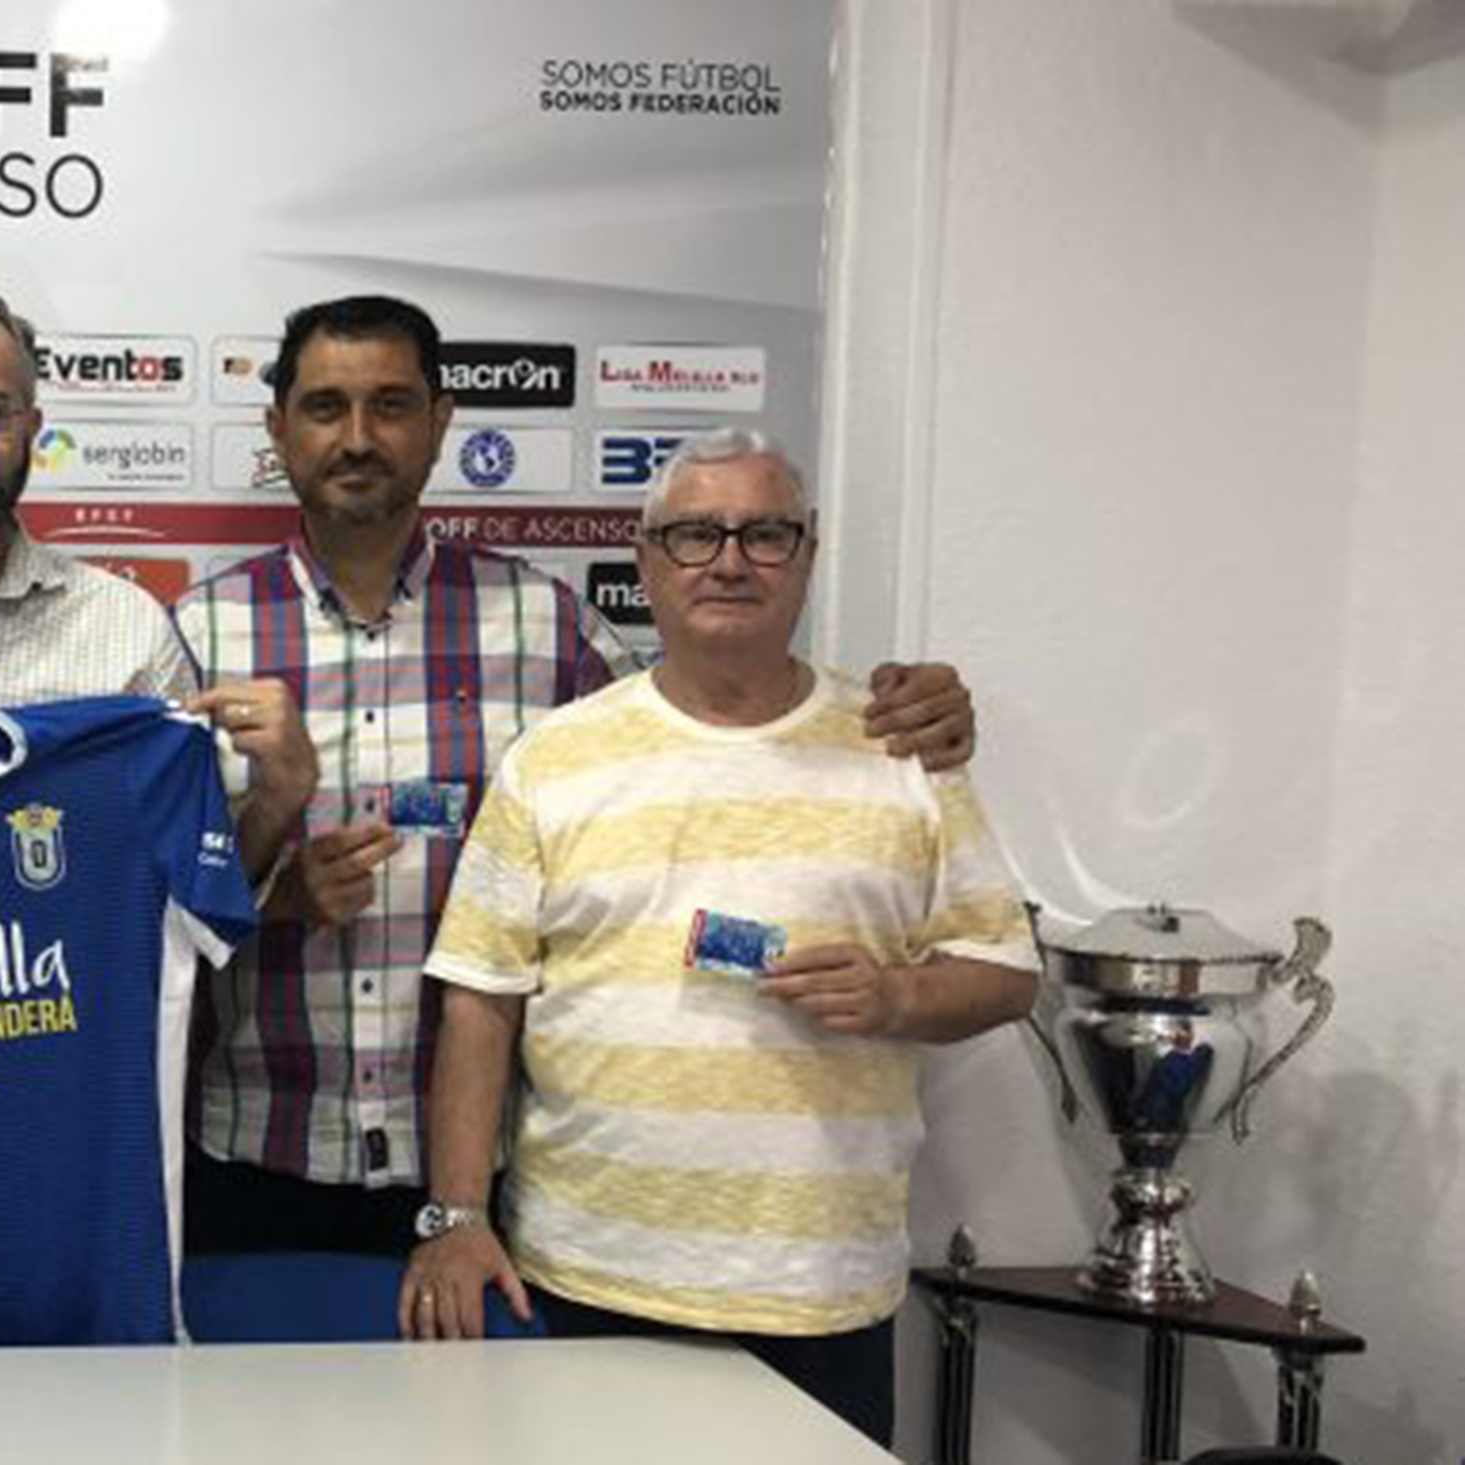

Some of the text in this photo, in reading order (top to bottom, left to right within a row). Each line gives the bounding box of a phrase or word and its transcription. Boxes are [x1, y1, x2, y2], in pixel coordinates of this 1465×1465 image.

[542, 59, 781, 92] SOMOS FÚTBOL
[539, 90, 781, 115] SOMOS FEDERACIÓN
[34, 347, 183, 381] Eventos
